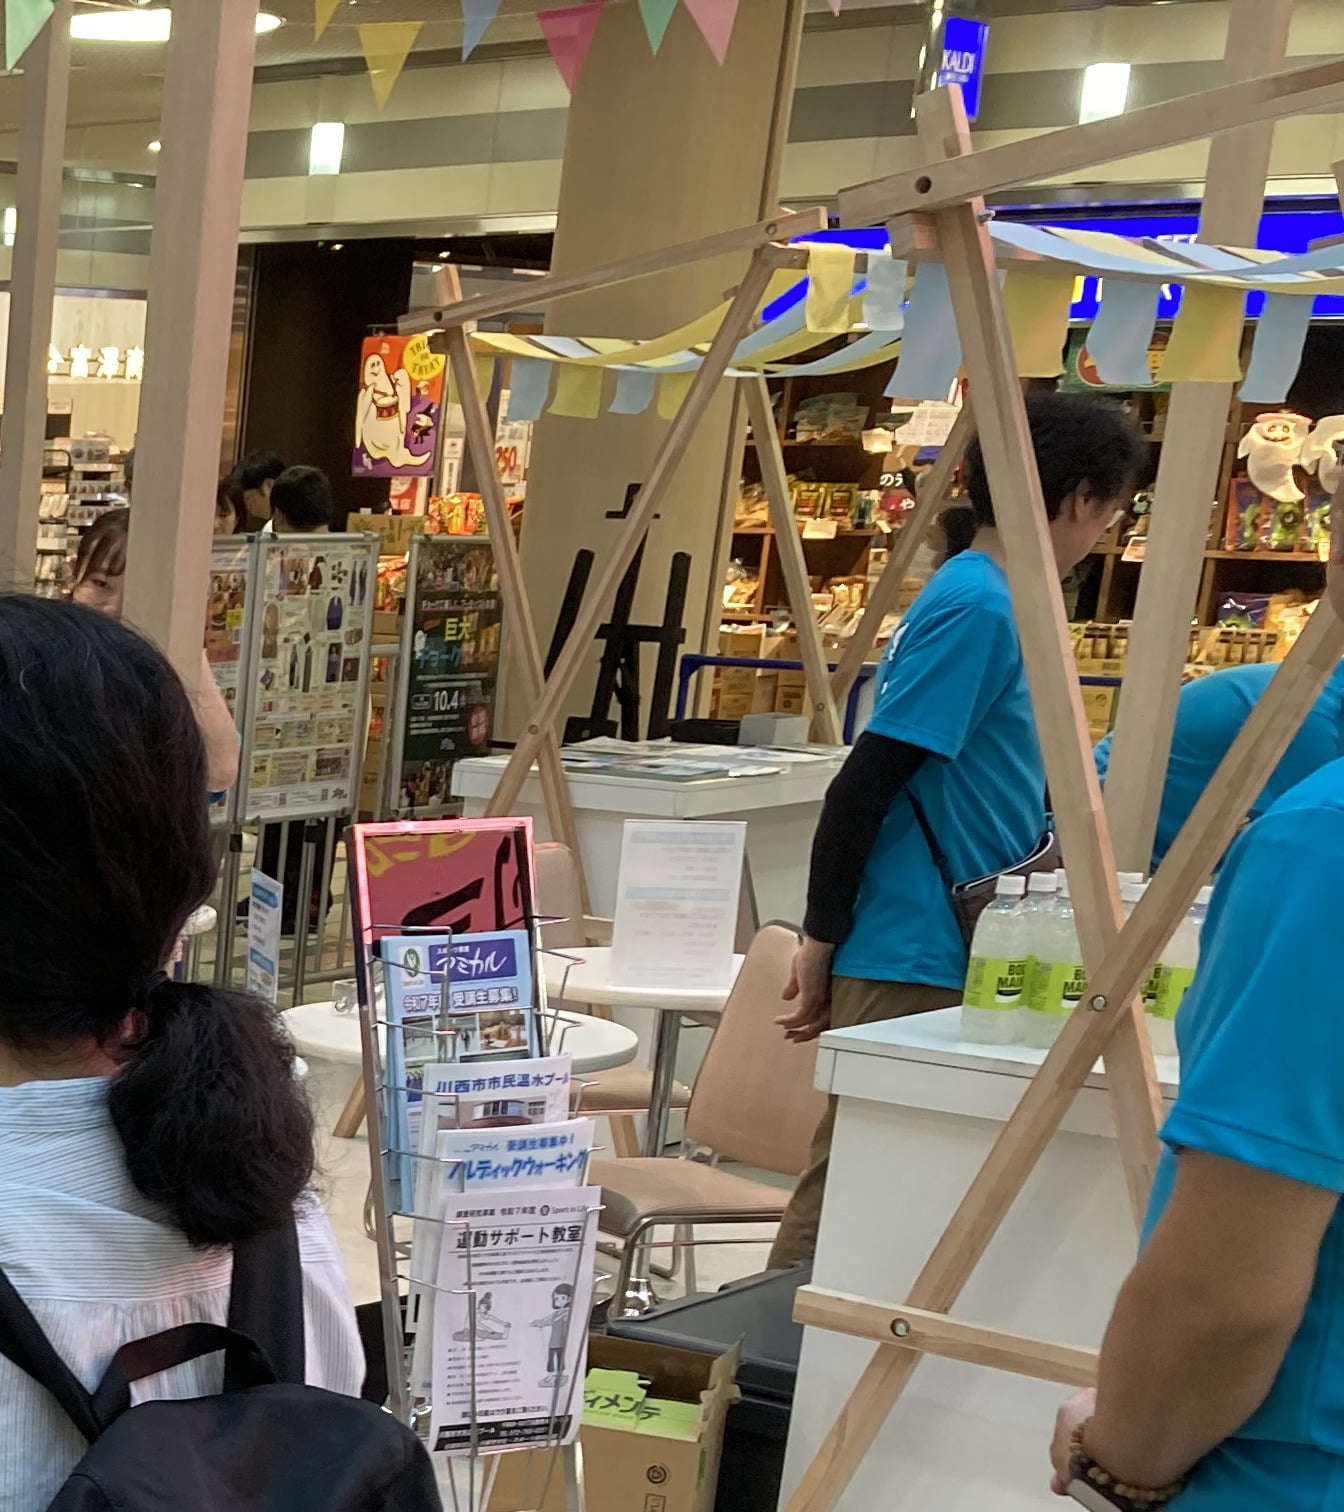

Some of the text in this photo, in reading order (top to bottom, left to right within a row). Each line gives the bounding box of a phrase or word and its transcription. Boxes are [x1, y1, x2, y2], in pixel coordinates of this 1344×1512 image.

[942, 49, 976, 74] KALDI
[412, 358, 441, 375] TREAT
[444, 617, 471, 642] 巨大
[433, 690, 459, 712] 10.4
[403, 993, 442, 1013] 令和7年
[456, 1225, 582, 1249] 運動サポート教室
